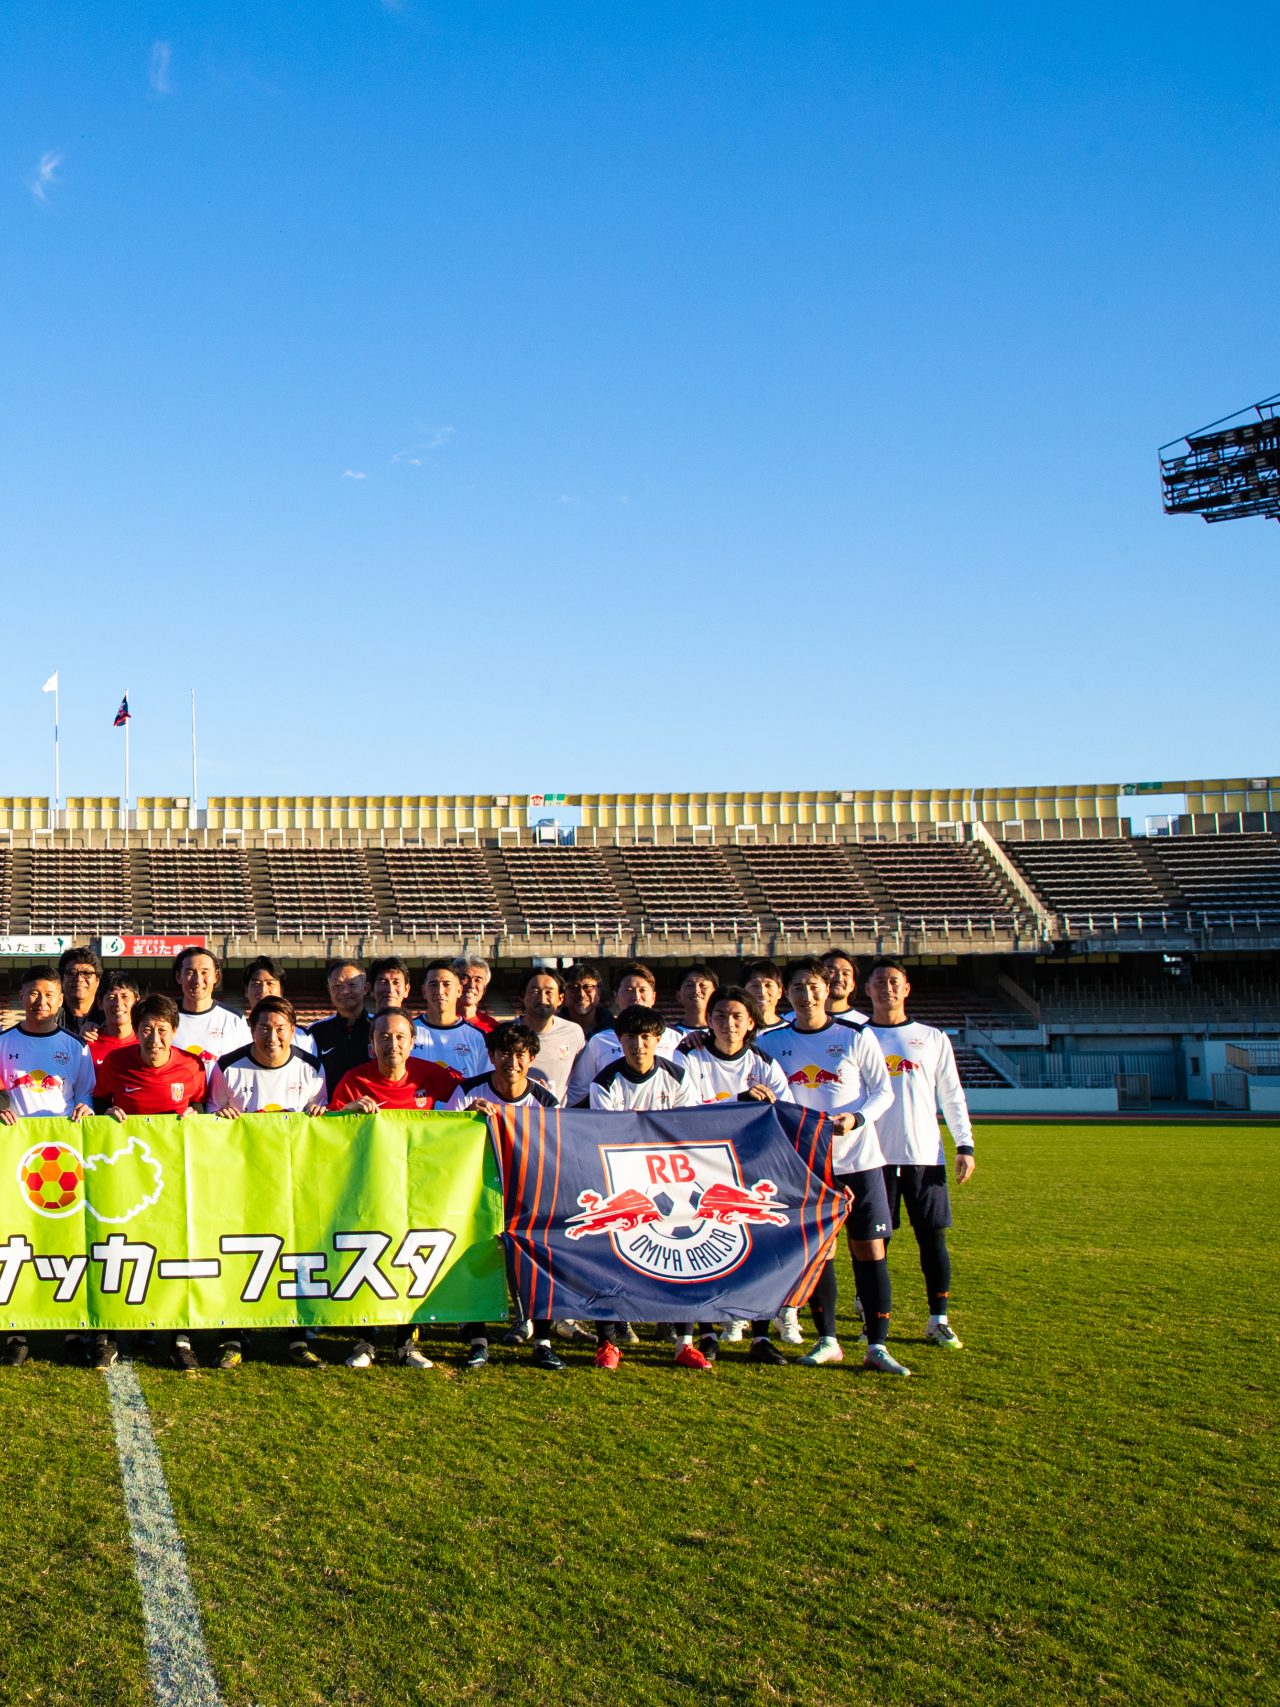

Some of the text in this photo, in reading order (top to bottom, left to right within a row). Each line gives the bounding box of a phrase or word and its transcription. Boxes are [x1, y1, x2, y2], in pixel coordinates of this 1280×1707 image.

[133, 944, 198, 954] さいたま
[645, 1153, 696, 1185] RB
[629, 1228, 737, 1272] OMIYA ARDIJA
